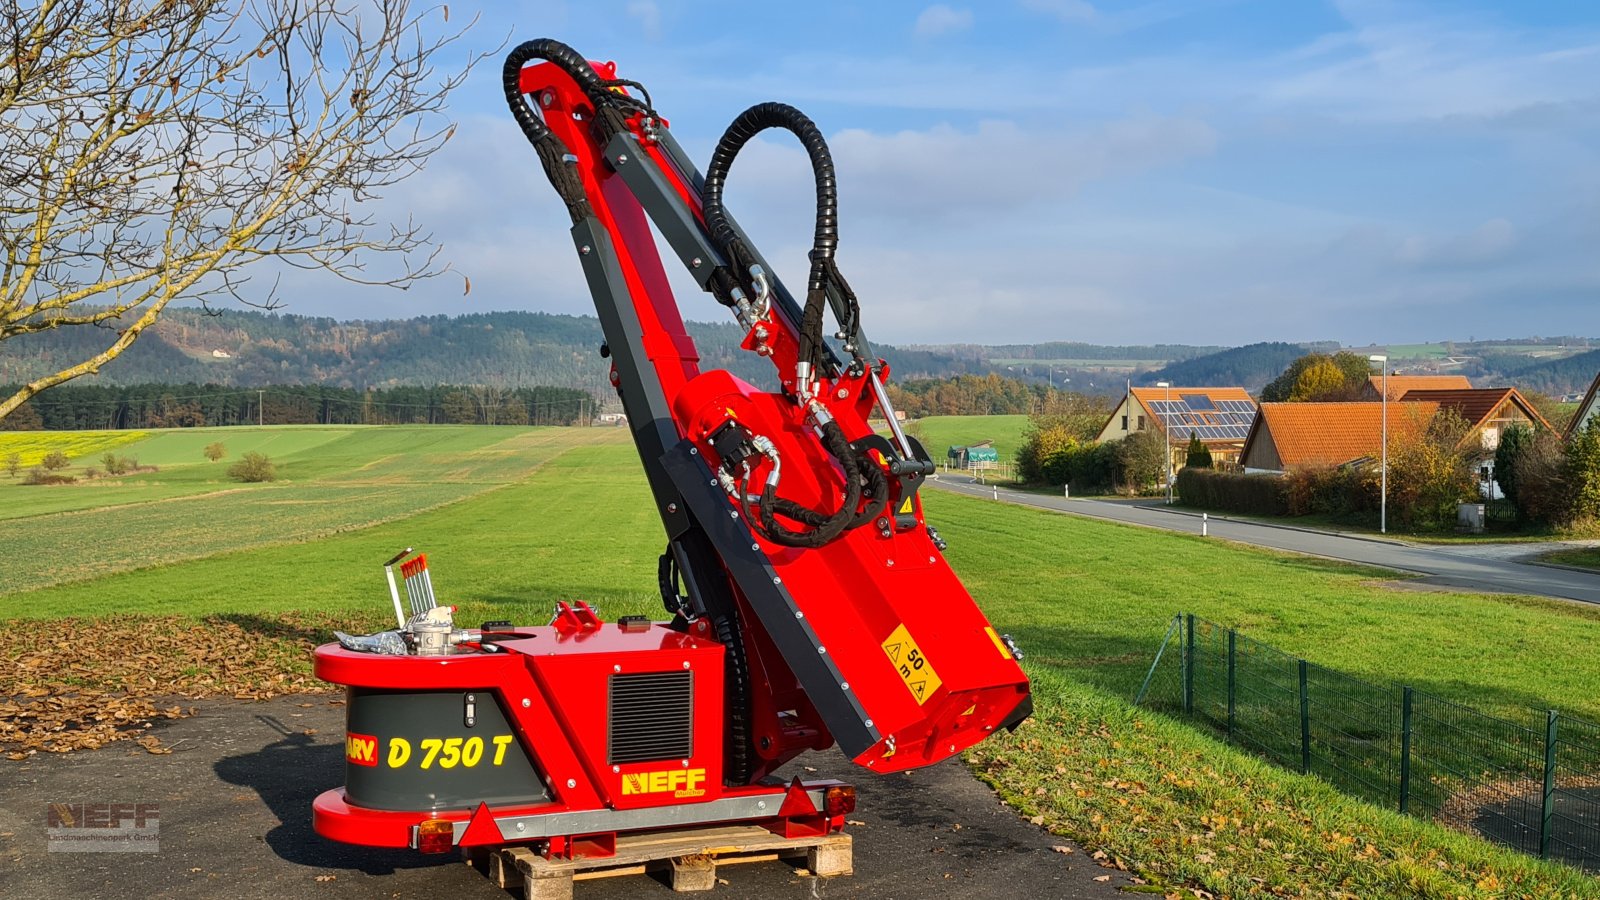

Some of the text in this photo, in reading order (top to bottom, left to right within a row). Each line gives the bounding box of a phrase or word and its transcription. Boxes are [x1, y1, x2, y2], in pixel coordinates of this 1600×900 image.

[899, 663, 911, 679] m
[908, 648, 924, 670] 50
[388, 734, 513, 770] D 750 T
[622, 768, 706, 795] NEFF
